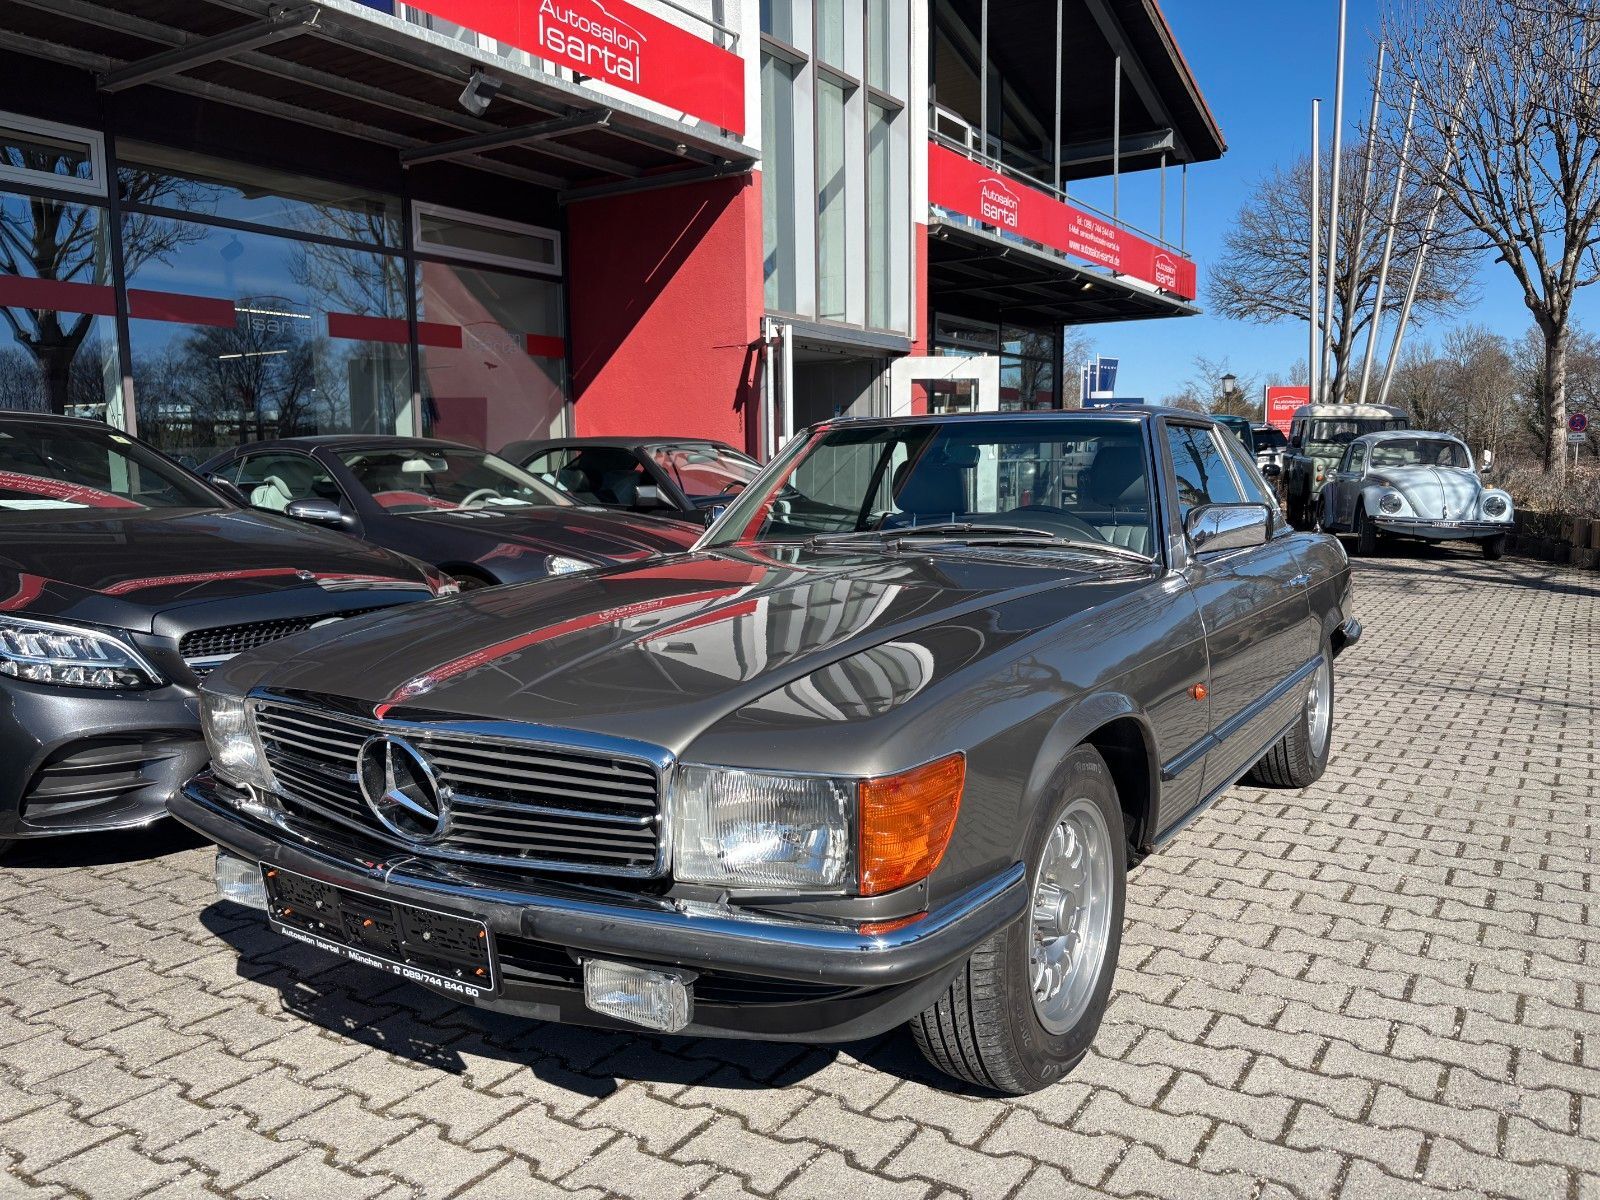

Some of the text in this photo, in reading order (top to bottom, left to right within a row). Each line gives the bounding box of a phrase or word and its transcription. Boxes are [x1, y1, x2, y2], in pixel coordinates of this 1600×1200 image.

[539, 0, 641, 54] Autosalon
[538, 14, 641, 84] Isartal
[980, 196, 1018, 228] Isartal
[981, 185, 1018, 210] Autosalon
[1155, 259, 1175, 275] Autosalon
[1155, 268, 1175, 288] Isartal
[281, 926, 480, 998] Autosalon Isartal München 089/744 244 60
